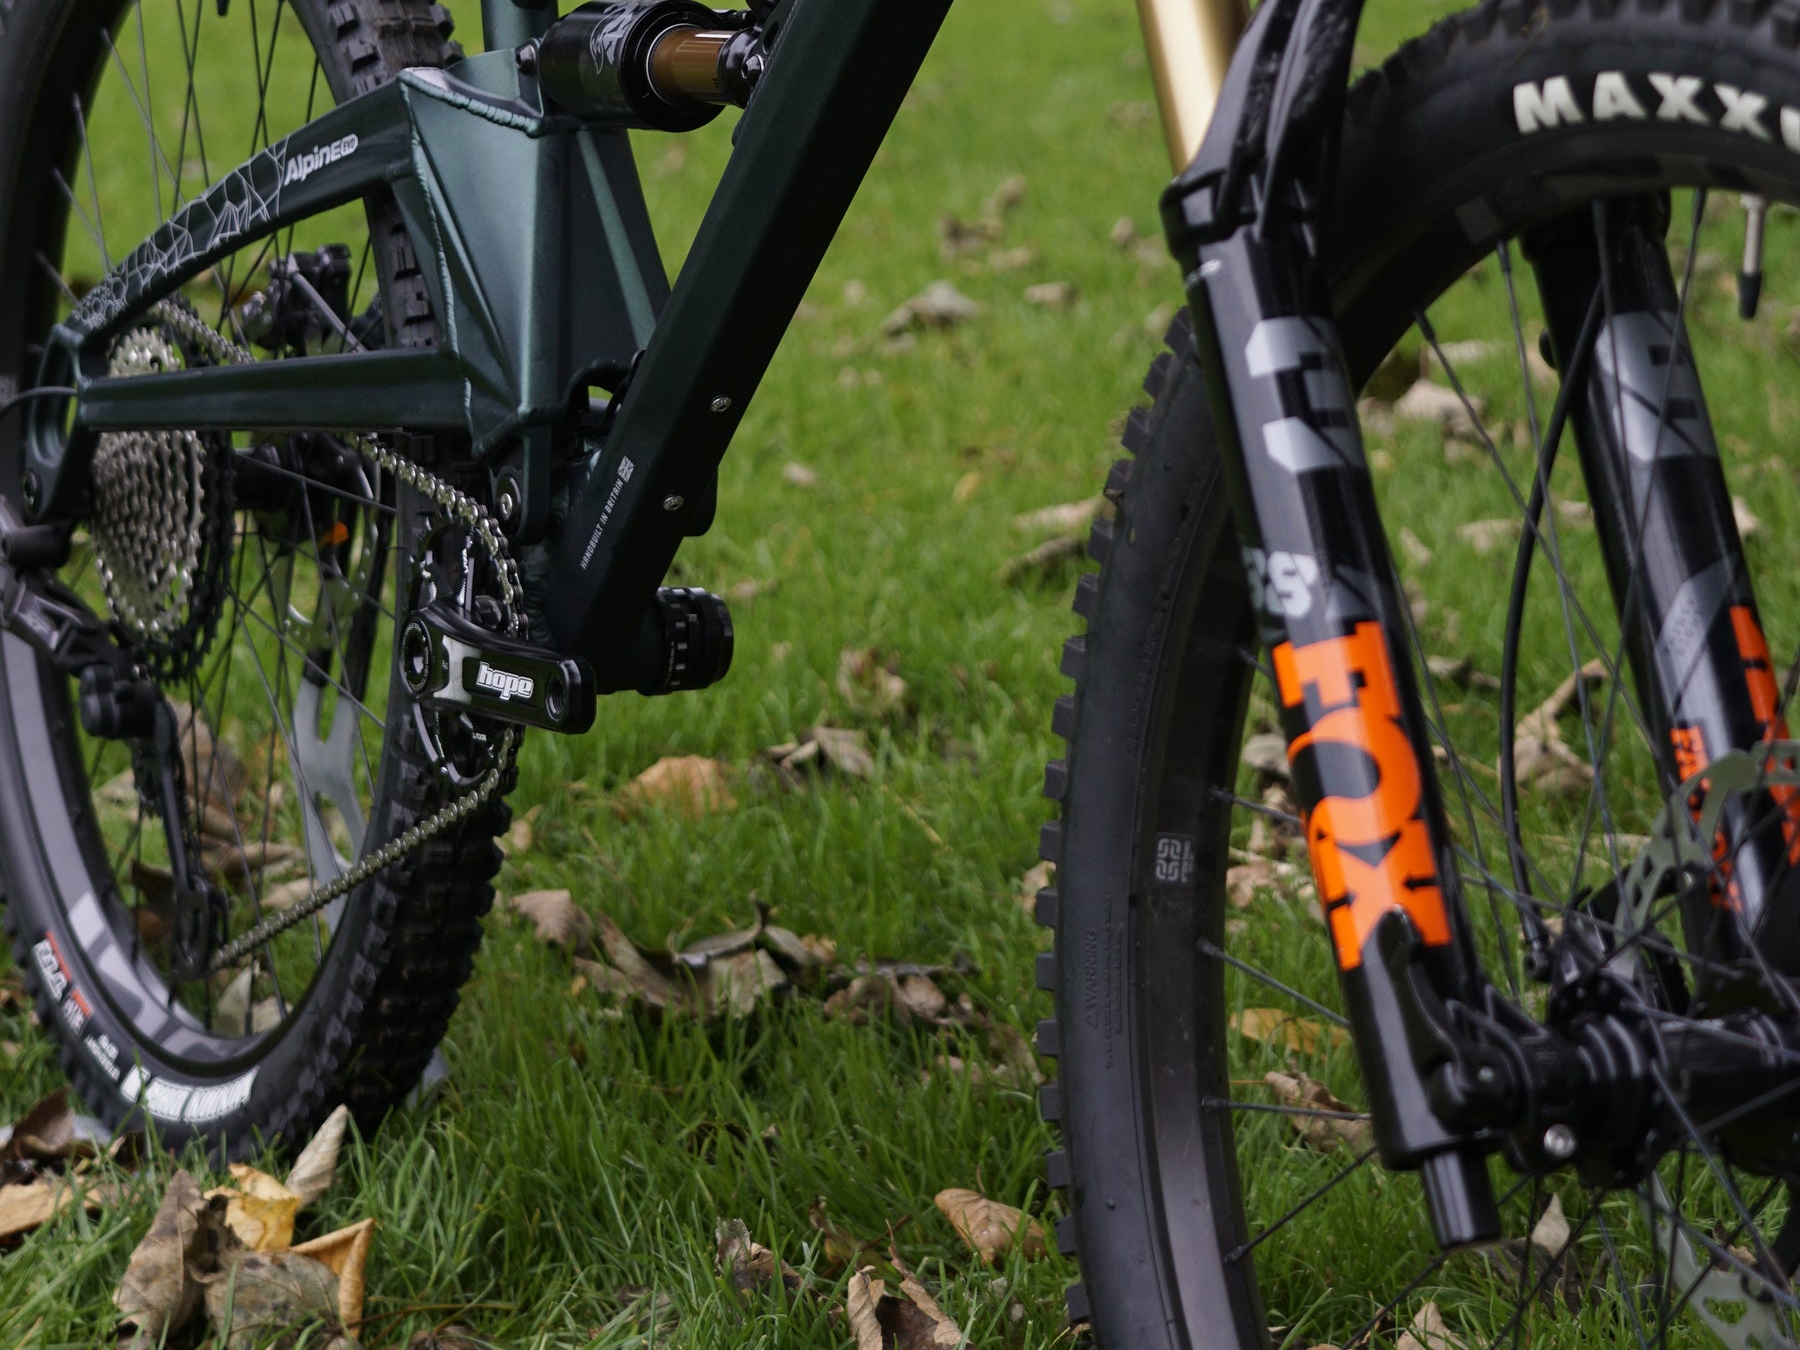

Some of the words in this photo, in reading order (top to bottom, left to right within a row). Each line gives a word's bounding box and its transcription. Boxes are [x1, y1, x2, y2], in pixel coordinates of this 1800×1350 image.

[604, 478, 624, 513] BRITAIN
[600, 512, 609, 525] IN
[580, 523, 604, 570] HANDBUILT
[476, 660, 535, 700] hope
[1272, 620, 1452, 971] FOX
[1084, 928, 1098, 1009] WARNING
